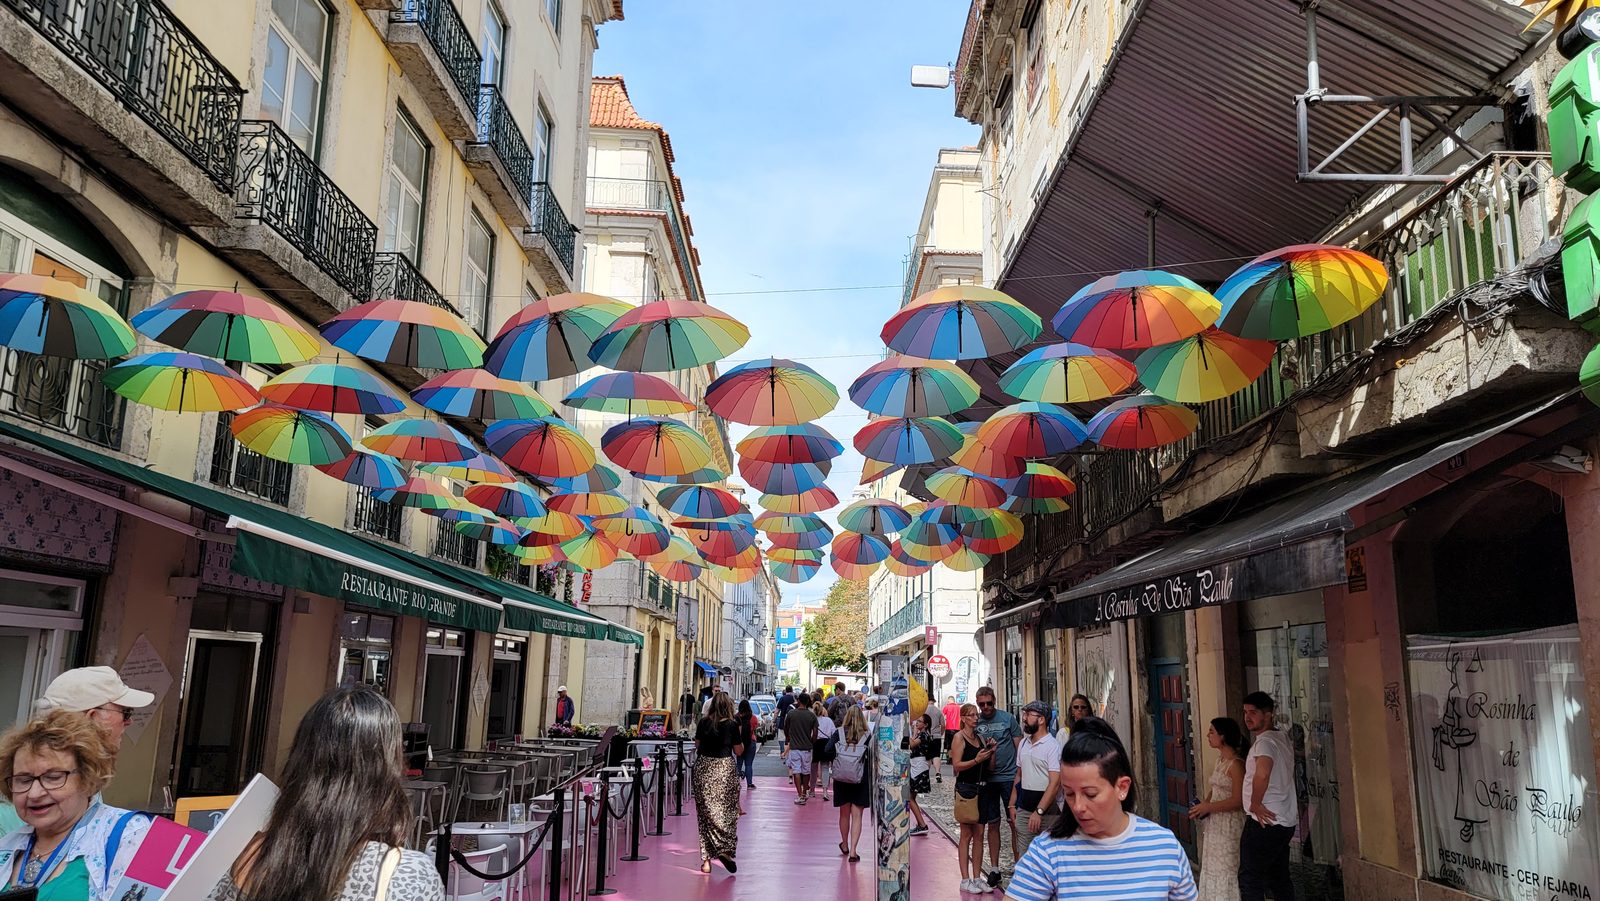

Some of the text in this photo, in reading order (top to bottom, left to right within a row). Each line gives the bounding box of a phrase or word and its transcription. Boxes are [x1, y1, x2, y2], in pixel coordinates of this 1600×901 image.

[341, 572, 457, 618] RESTAURANTE RIO GRANDE
[1095, 566, 1234, 621] A Rosinha De São Paulo
[1465, 647, 1484, 673] A
[1465, 691, 1537, 721] Rosinha
[1502, 741, 1520, 767] de
[1474, 779, 1582, 823] São Paulo
[1438, 847, 1509, 879] RESTAURANTE
